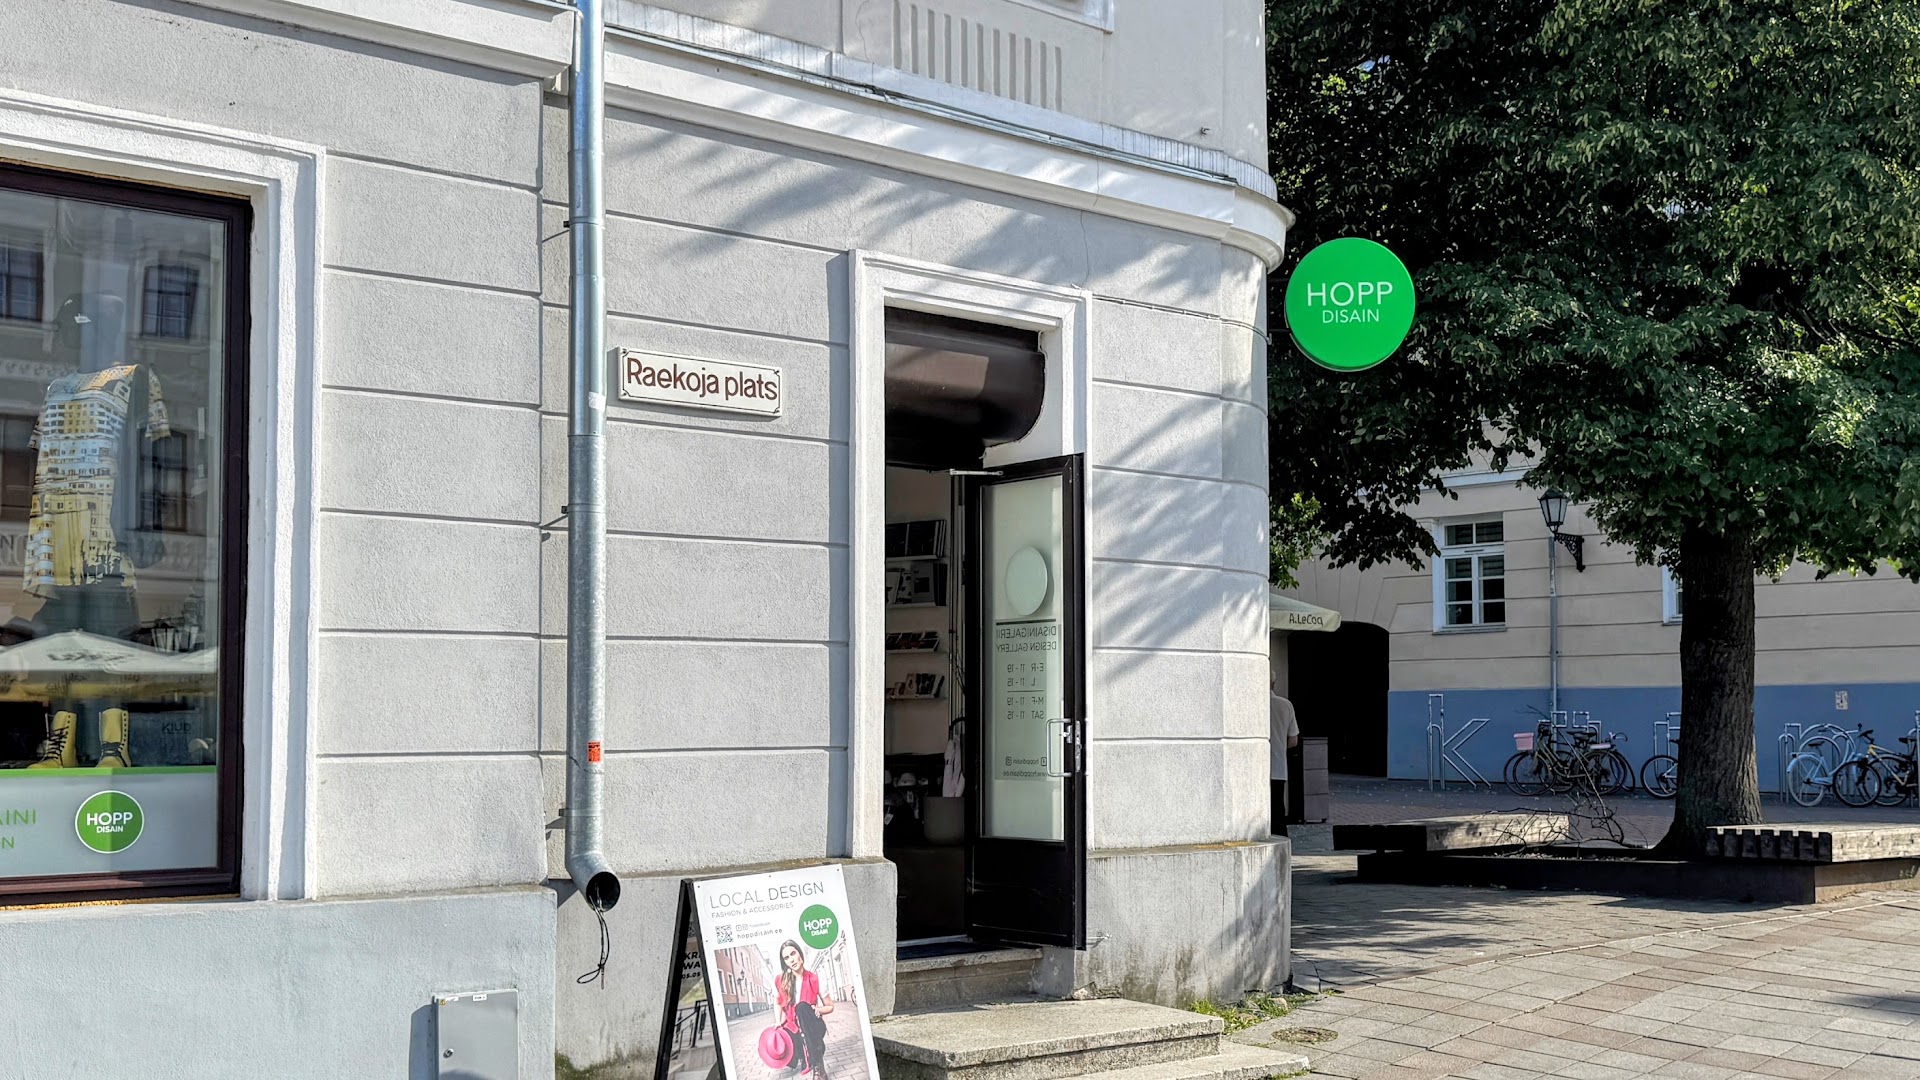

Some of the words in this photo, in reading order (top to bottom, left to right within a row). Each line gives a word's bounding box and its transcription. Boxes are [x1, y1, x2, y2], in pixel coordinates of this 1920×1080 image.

[1307, 282, 1393, 306] HOPP
[1322, 309, 1380, 323] DISAIN
[627, 357, 719, 398] Raekoja
[725, 371, 778, 401] plats
[86, 811, 133, 826] HOPP
[96, 825, 124, 834] DISAIN
[709, 888, 764, 909] LOCAL
[768, 881, 824, 901] DESIGN
[711, 909, 742, 919] FASHION
[749, 902, 794, 914] ACCESSORIES
[803, 917, 832, 932] HOPP
[811, 929, 829, 937] DISAIN
